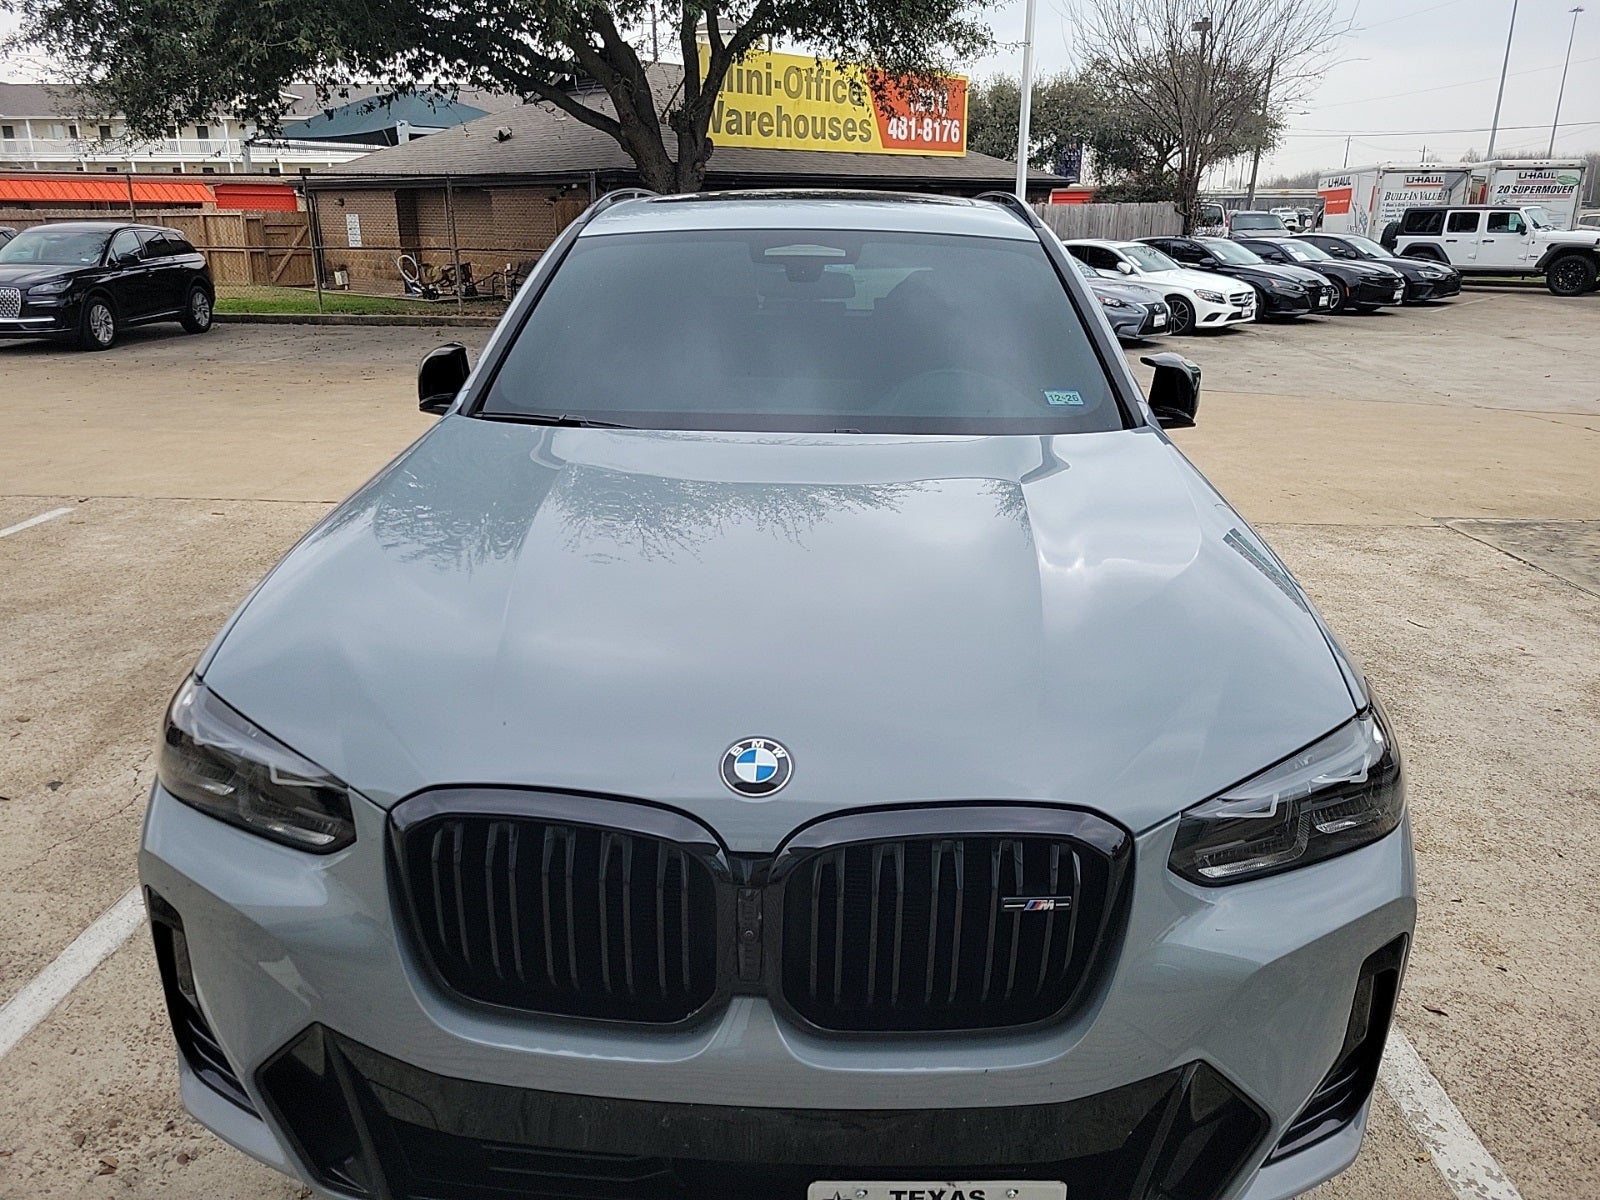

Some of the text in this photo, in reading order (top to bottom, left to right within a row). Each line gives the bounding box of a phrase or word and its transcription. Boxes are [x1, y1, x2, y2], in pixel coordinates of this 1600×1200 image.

[887, 116, 960, 143] 481-8176
[1328, 176, 1352, 187] U-HAUL
[1511, 185, 1575, 194] SUPERMOVER
[1384, 191, 1418, 201] BUILT-IN
[730, 740, 786, 758] BMW
[889, 1190, 986, 1200] TEXAS
